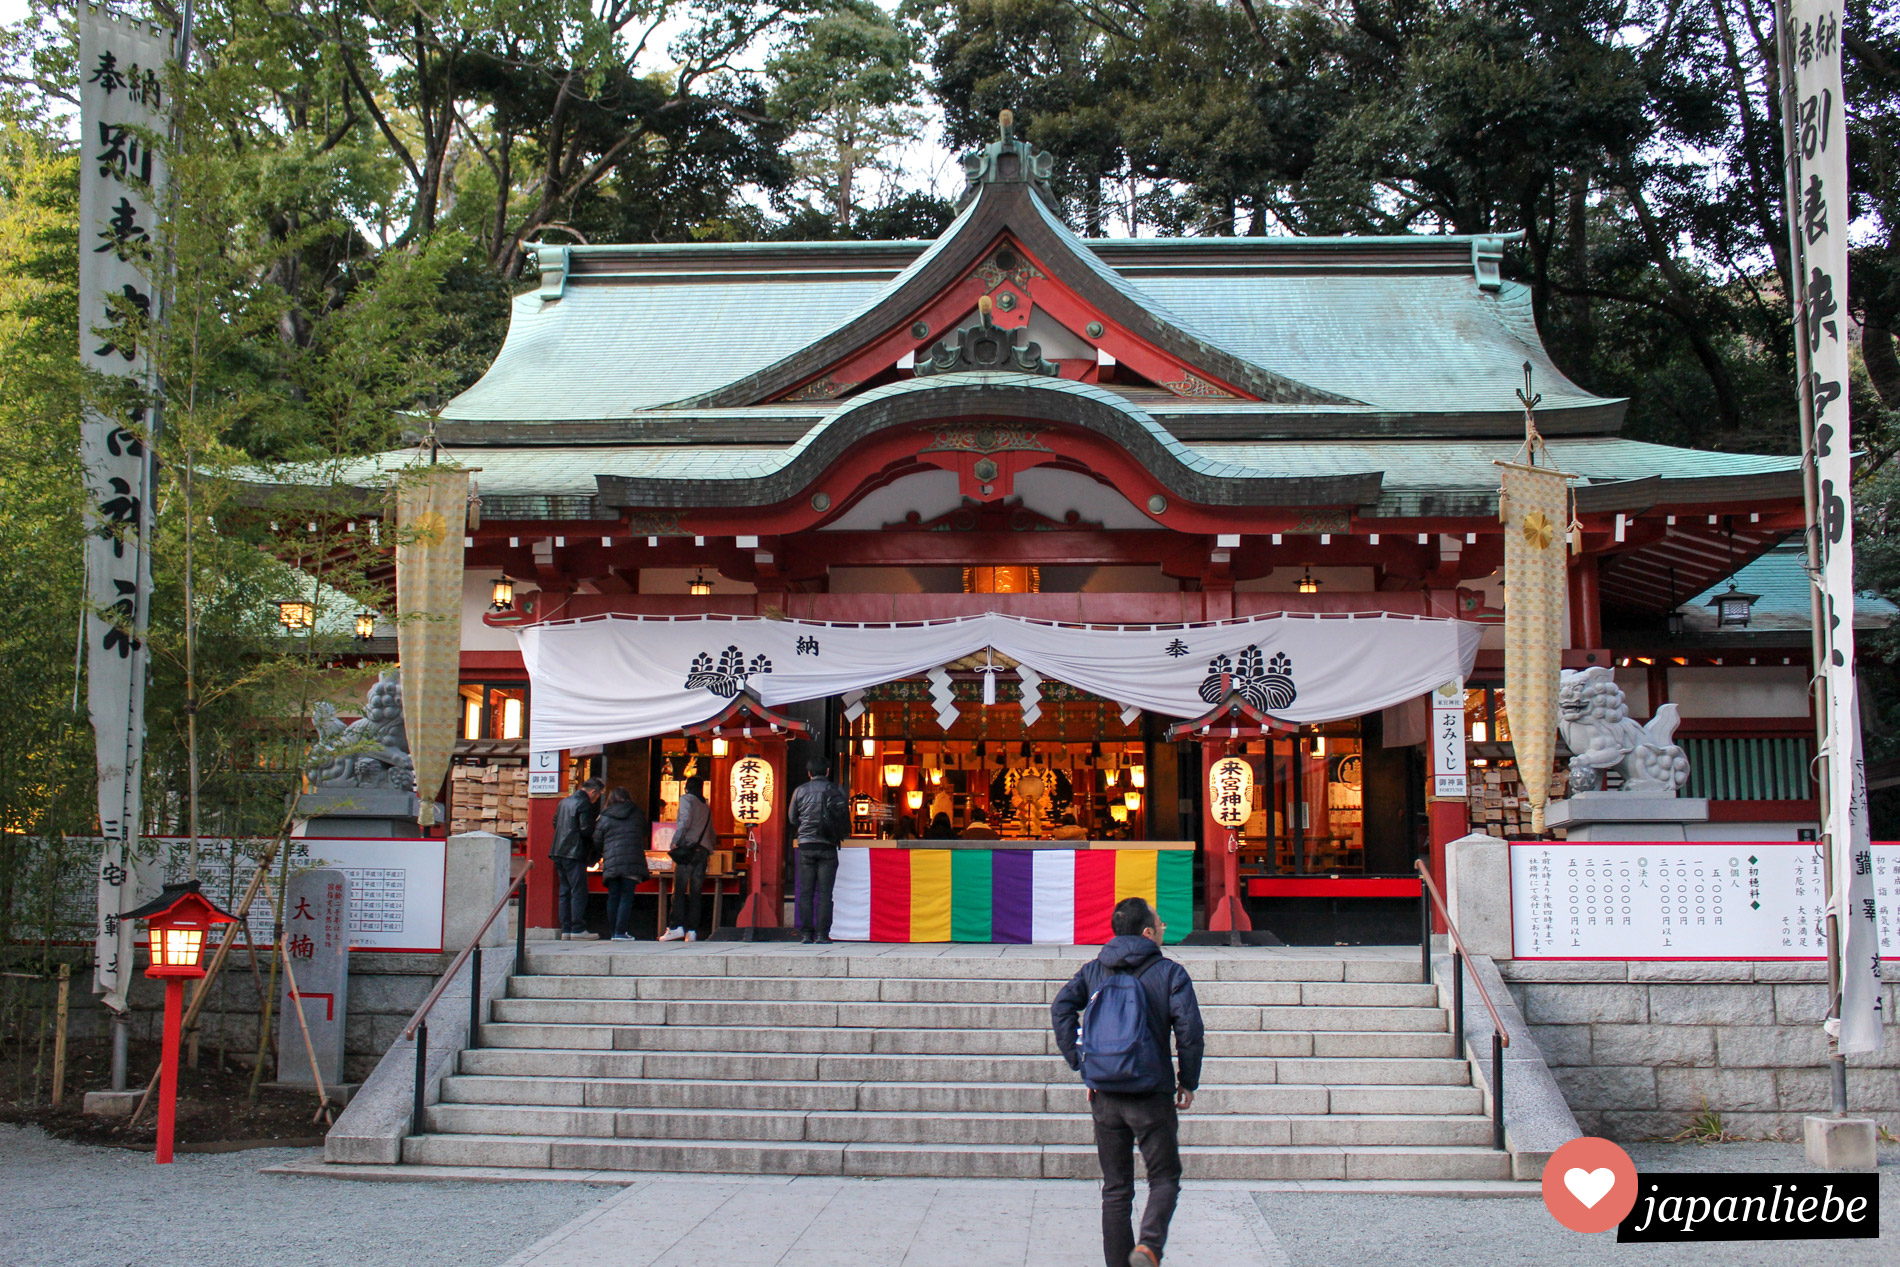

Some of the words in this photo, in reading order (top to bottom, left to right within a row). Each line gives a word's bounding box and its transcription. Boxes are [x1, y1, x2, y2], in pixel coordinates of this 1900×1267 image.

[1798, 10, 1837, 70] 奉納
[796, 635, 820, 657] 納
[1165, 638, 1191, 659] 奉
[1442, 713, 1458, 770] おみくじ
[738, 760, 762, 821] 来宮神社
[1219, 760, 1244, 822] 来宮神社
[1794, 855, 1806, 897] 八方厄除
[1811, 855, 1821, 896] 星まつり
[290, 896, 316, 960] 大楠
[1782, 916, 1792, 947] その他
